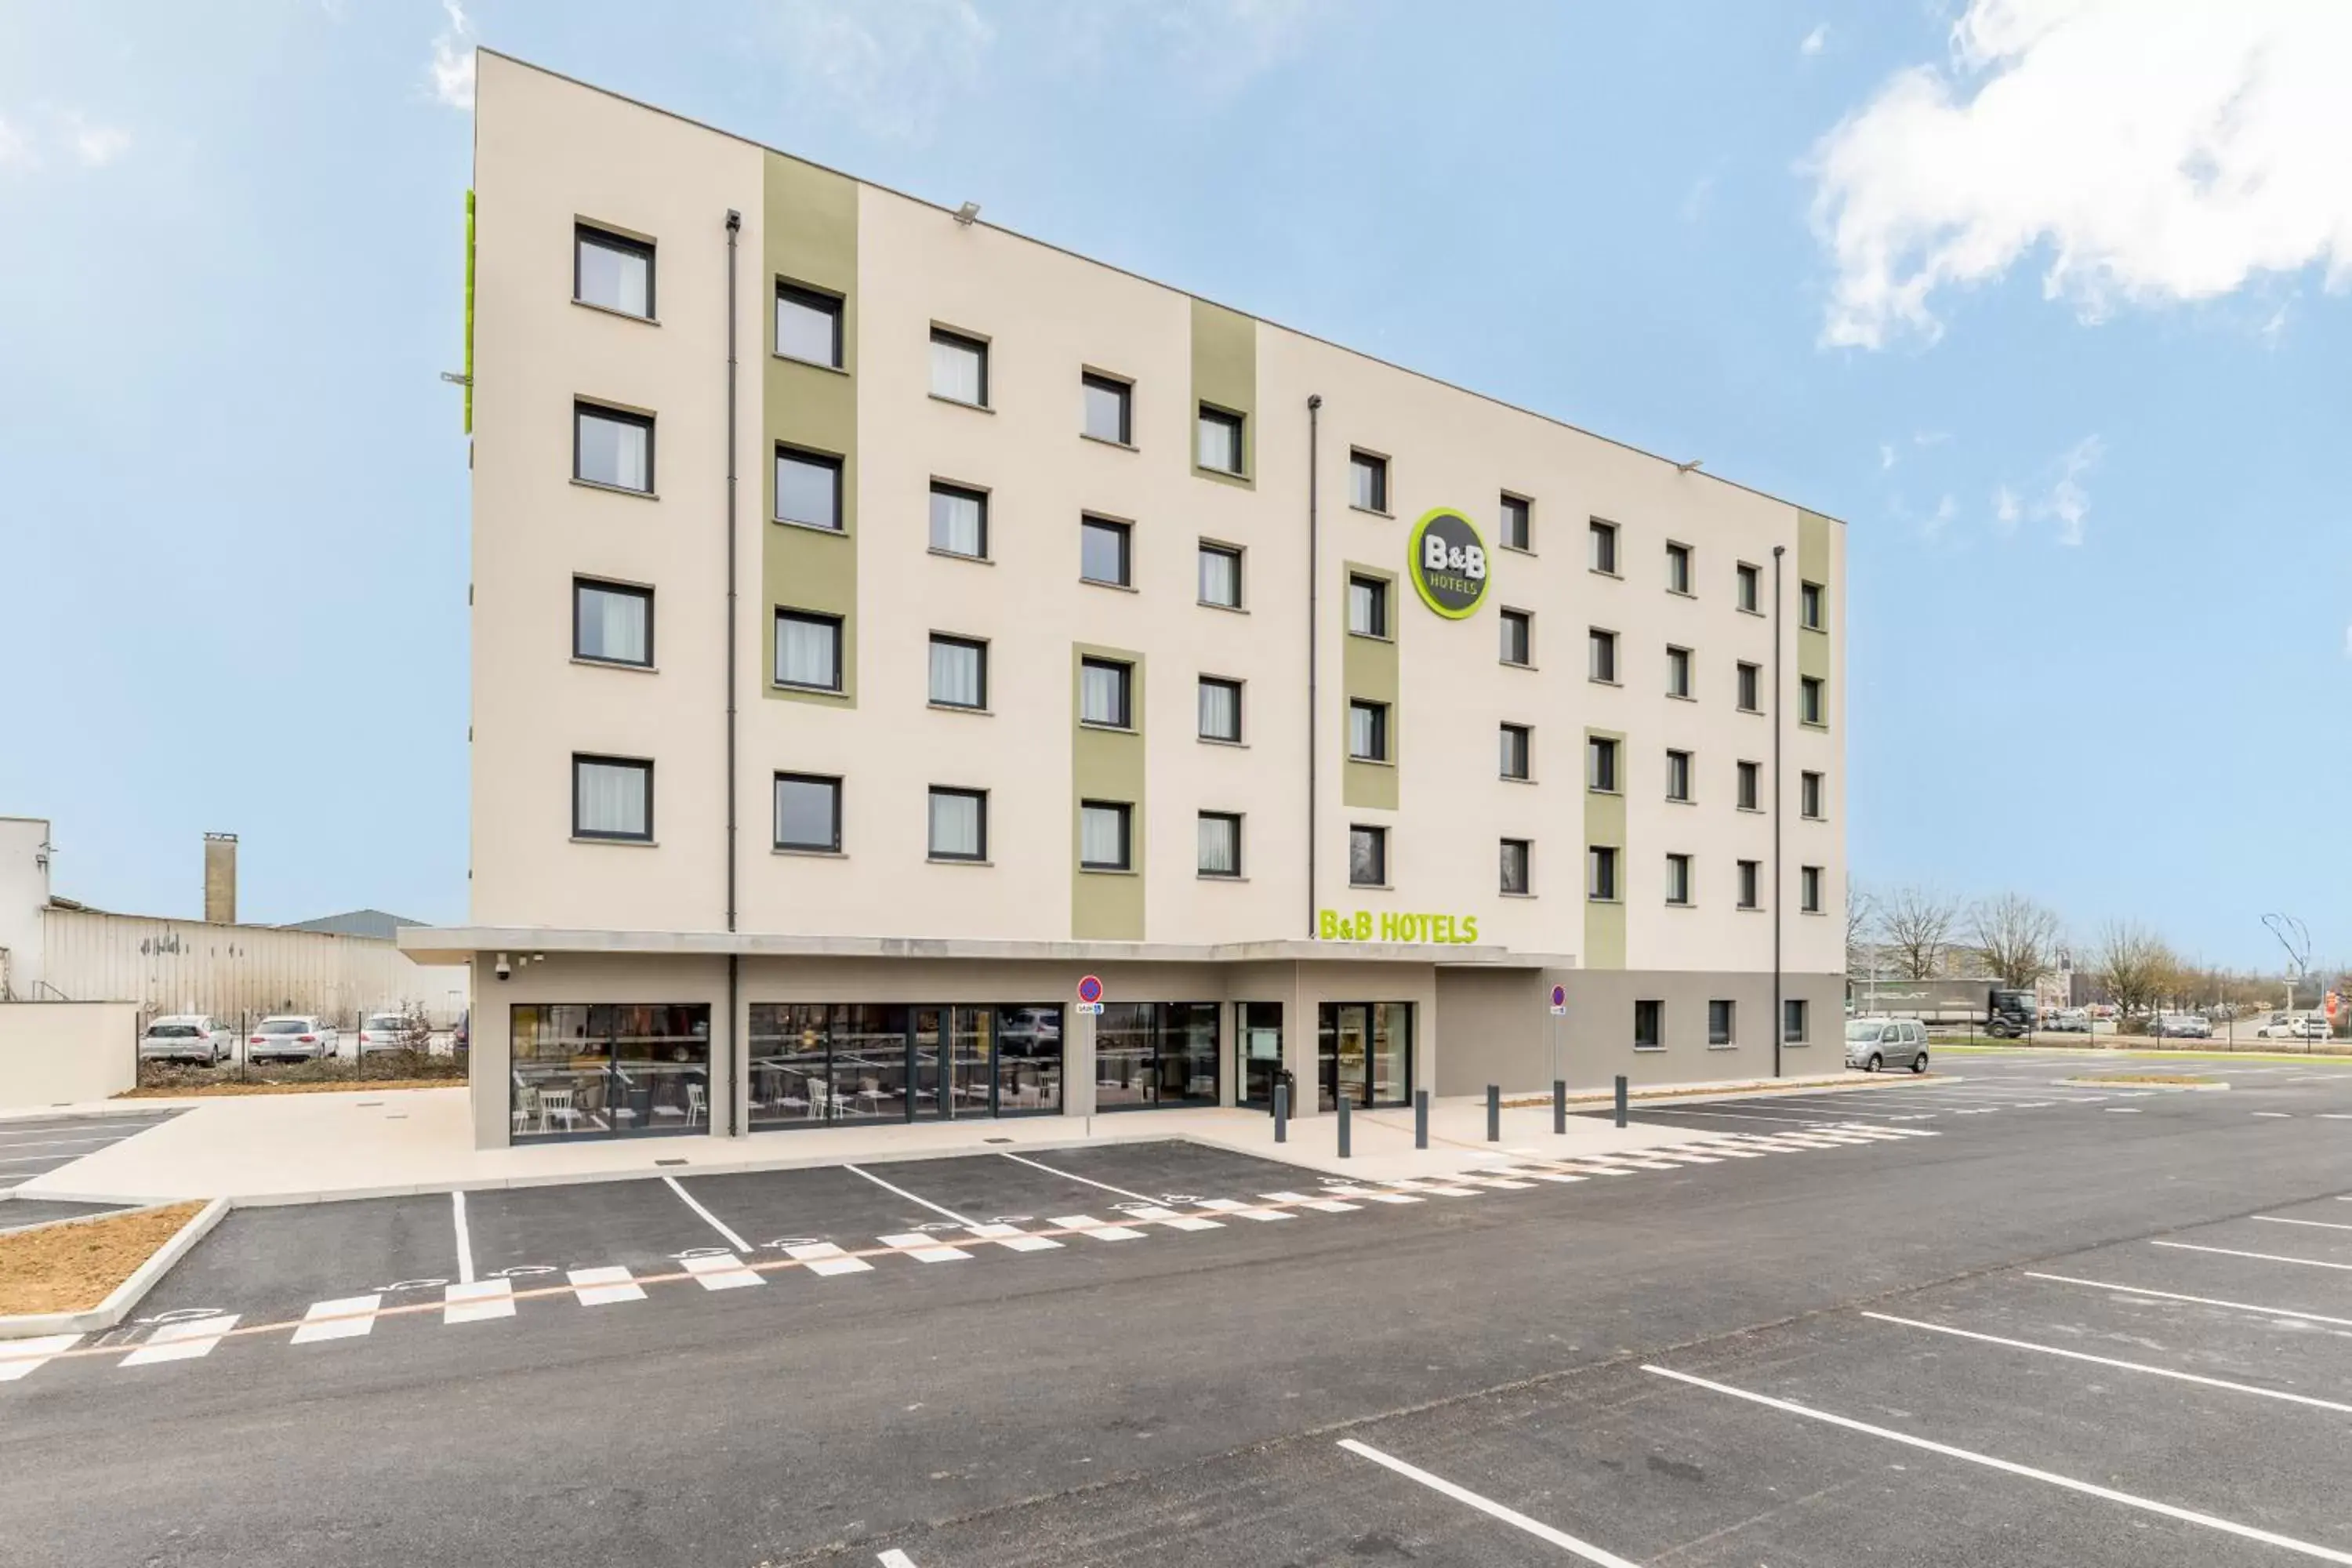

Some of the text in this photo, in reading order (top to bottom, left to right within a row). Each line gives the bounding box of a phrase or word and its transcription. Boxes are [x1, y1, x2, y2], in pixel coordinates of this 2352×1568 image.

[1425, 534, 1486, 579] B&B
[1430, 573, 1477, 595] HOTELS
[1319, 909, 1479, 944] B&B HOTELS
